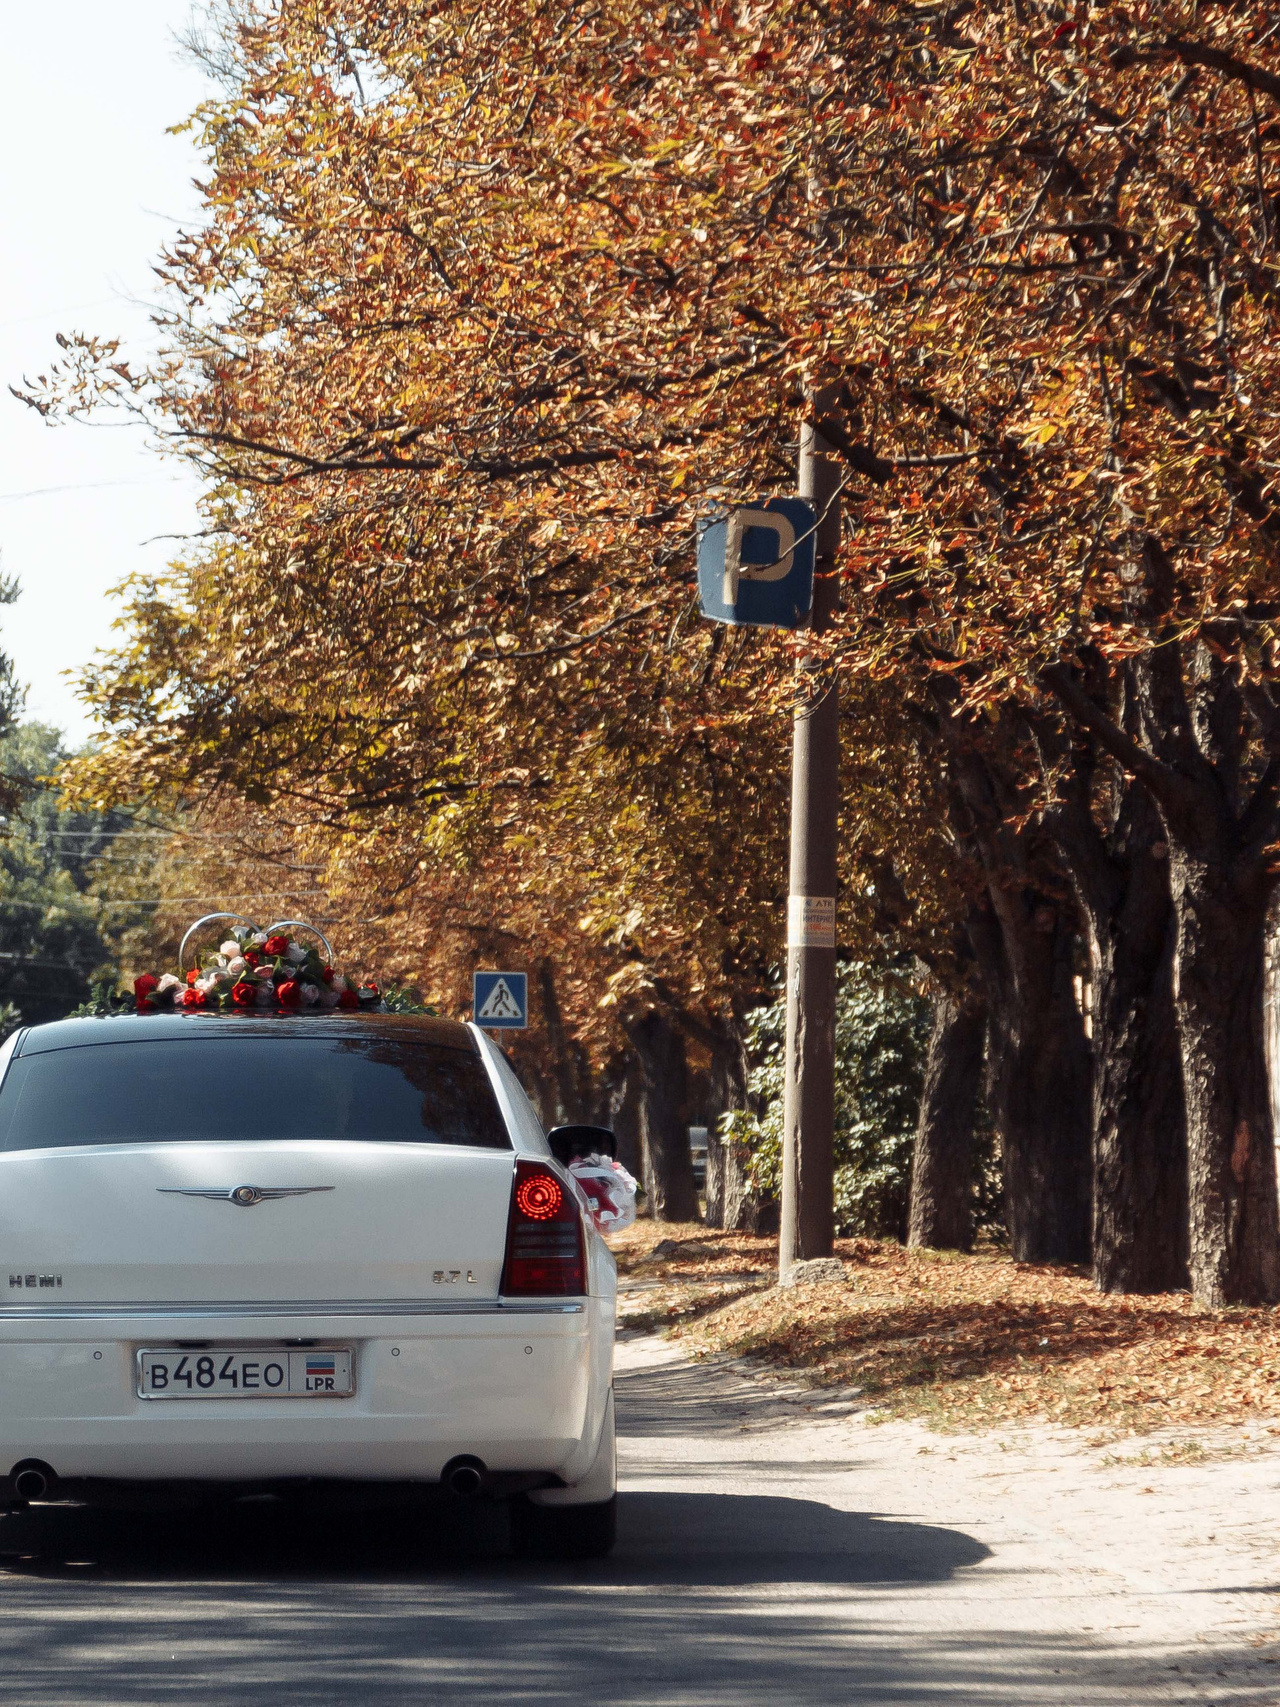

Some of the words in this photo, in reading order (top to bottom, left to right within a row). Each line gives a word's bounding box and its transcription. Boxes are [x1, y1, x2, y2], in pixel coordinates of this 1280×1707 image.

[723, 508, 795, 605] P
[9, 1274, 62, 1288] HEMI
[305, 1377, 335, 1391] LPR
